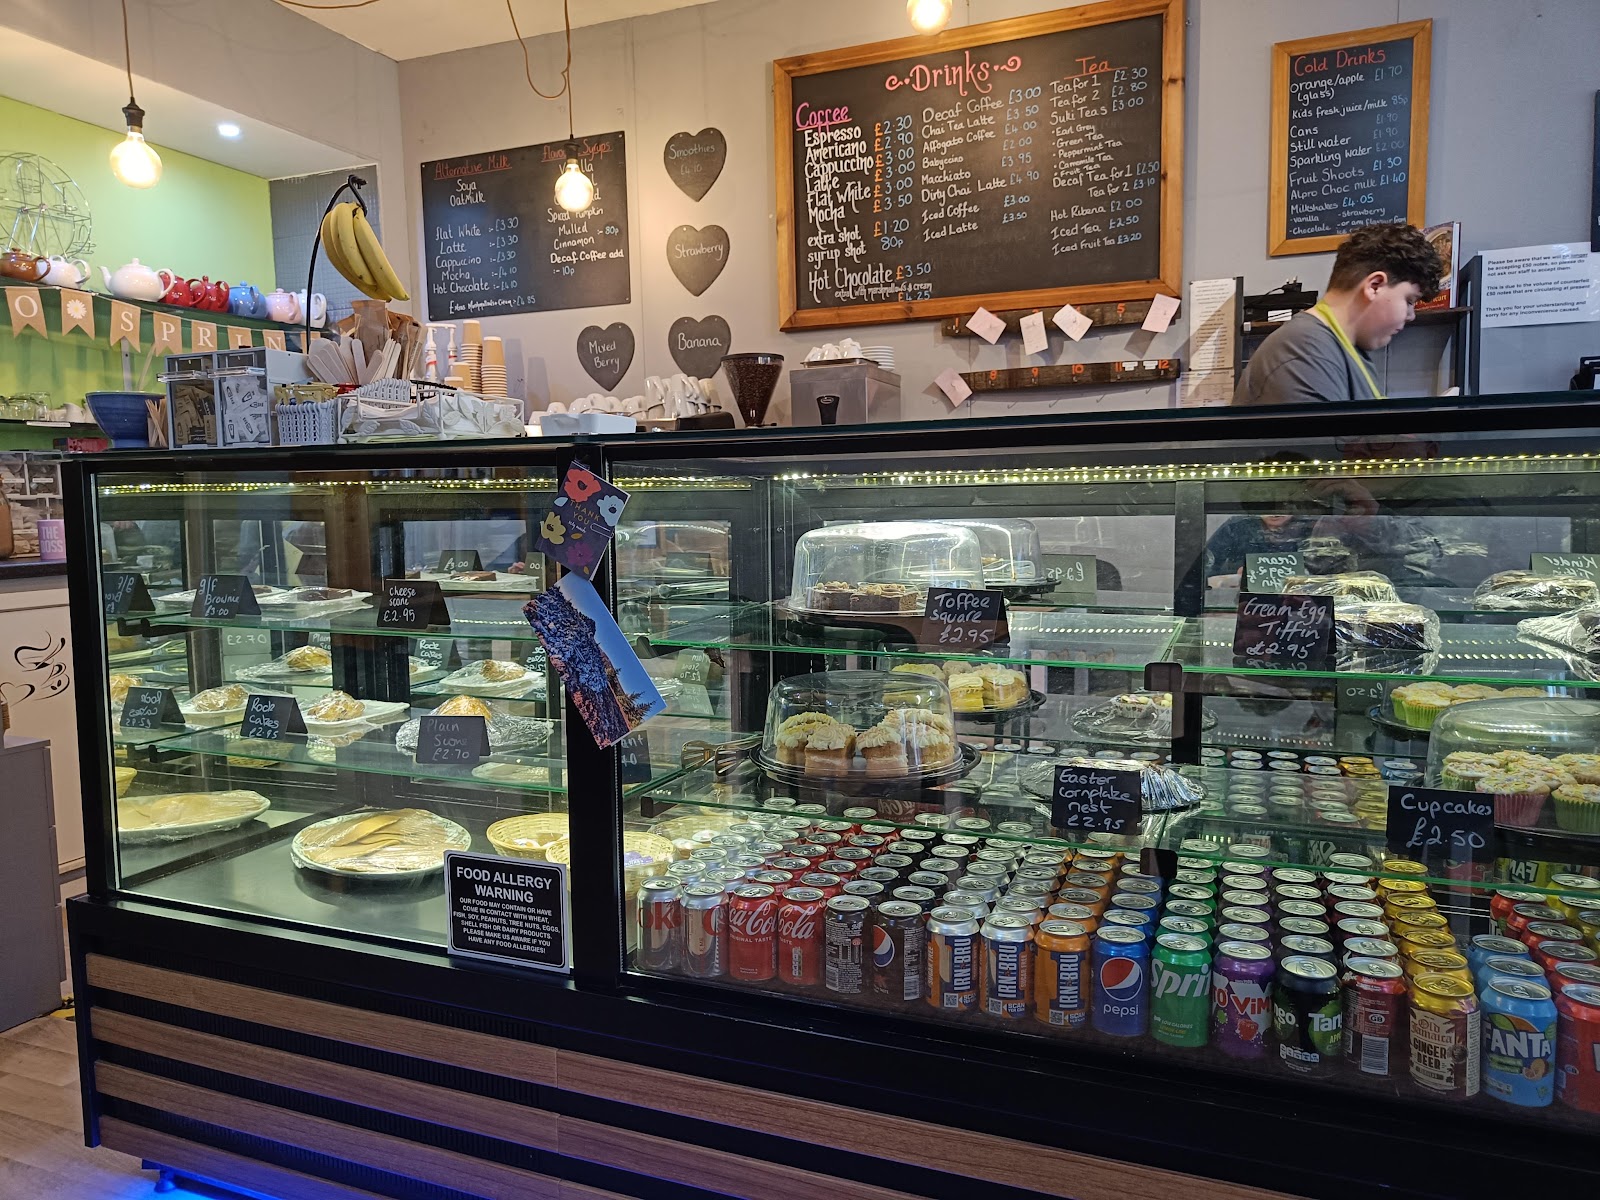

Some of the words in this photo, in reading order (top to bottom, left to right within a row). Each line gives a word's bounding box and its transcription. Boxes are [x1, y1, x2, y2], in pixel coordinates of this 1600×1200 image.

[1075, 56, 1111, 75] Tea
[1294, 56, 1328, 77] Cold
[1336, 48, 1386, 68] Drinks
[910, 50, 993, 96] Drinks
[1049, 81, 1072, 94] Tea
[1072, 77, 1089, 92] for
[1092, 75, 1101, 87] 1
[1049, 96, 1071, 108] Tea
[1071, 94, 1087, 108] for
[1092, 90, 1100, 101] 2
[796, 102, 849, 134] Coffee
[922, 102, 962, 123] Decaf
[967, 96, 1005, 113] Coffee
[1049, 109, 1076, 126] Suki
[1292, 109, 1313, 119] Kids
[1316, 106, 1340, 118] fresh
[922, 125, 945, 139] Chai
[947, 119, 964, 131] Tea
[967, 115, 996, 128] Latte
[1056, 126, 1075, 137] Earl
[1076, 124, 1096, 134] Grey
[1290, 125, 1319, 138] Cans
[804, 126, 862, 147] Espresso
[922, 137, 964, 155] Affogato
[966, 130, 996, 143] Coffee
[1056, 138, 1083, 149] Green
[1084, 132, 1105, 141] Tea
[1290, 139, 1315, 153] Still
[1318, 136, 1352, 149] water
[805, 140, 867, 163] Americano
[1058, 143, 1104, 159] Peppermint
[1104, 140, 1123, 148] Tea
[1095, 152, 1114, 161] Tea
[435, 161, 483, 179] Alternative
[488, 155, 511, 169] Milk
[804, 156, 874, 178] Cappuccino
[922, 154, 964, 170] Babyccino
[1290, 151, 1341, 169] Sparkling
[921, 169, 971, 185] Macchiato
[1052, 172, 1084, 188] Decaf
[1060, 168, 1081, 177] Fruit
[1289, 171, 1319, 187] Fruit
[1321, 167, 1365, 182] Shoots
[456, 179, 477, 194] Soya
[806, 176, 840, 194] Latte
[921, 188, 946, 206] Dirty
[947, 183, 972, 198] Chai
[977, 177, 1007, 192] Latte
[1087, 185, 1105, 197] Tea
[1122, 182, 1130, 191] 2
[1290, 189, 1318, 201] Alpro
[1321, 184, 1350, 196] Choc
[922, 208, 945, 224] Iced
[947, 201, 980, 218] Coffee
[1050, 209, 1069, 222] Hot
[1290, 201, 1339, 215] Milkshakes
[808, 205, 846, 232] Mocha
[558, 221, 588, 236] Mulled
[838, 225, 862, 247] shot
[923, 226, 946, 242] Iced
[949, 221, 978, 235] Latte
[1050, 224, 1079, 240] Iced
[1080, 222, 1102, 234] Tea
[440, 242, 467, 255] Latte
[553, 236, 595, 250] Cinnamon
[674, 242, 724, 261] Strawberry
[1051, 243, 1078, 256] Iced
[1080, 238, 1101, 250] Fruit
[550, 251, 578, 264] Decaf
[579, 250, 606, 262] Coffee
[609, 249, 624, 258] add
[807, 248, 841, 269] syrup
[845, 241, 867, 263] shot
[881, 236, 903, 250] 80p
[436, 256, 482, 271] Cappuccino
[441, 270, 470, 281] Mocha
[808, 270, 832, 303] Hot
[835, 263, 893, 299] Chocolate
[433, 283, 448, 294] Hot
[450, 278, 490, 293] Chocolate
[14, 296, 38, 318] O
[1117, 303, 1125, 313] 5
[588, 341, 617, 355] Mixed
[678, 332, 722, 351] Banana
[594, 356, 620, 374] Berry
[1072, 364, 1084, 374] 10
[570, 500, 600, 522] THANK
[573, 511, 590, 526] YOU
[41, 526, 59, 540] THE
[41, 540, 63, 553] BOSS
[935, 593, 990, 610] Toffee
[383, 609, 416, 622] £2.95
[1244, 597, 1292, 617] Cream
[1300, 600, 1327, 626] Egg
[227, 634, 267, 645] £2.70
[939, 626, 993, 643] £2.95
[1258, 621, 1320, 641] Tiffin
[1247, 642, 1315, 658] £2.95
[251, 697, 276, 713] Rock
[249, 727, 278, 739] £2.95
[427, 718, 460, 732] Plain
[432, 749, 470, 761] £2.70
[1059, 769, 1116, 785] Easter
[1068, 802, 1112, 814] nest
[1401, 793, 1492, 819] Cupcakes
[1406, 816, 1485, 849] £2.50
[457, 866, 491, 882] FOOD
[493, 872, 552, 890] ALLERGY
[475, 884, 534, 903] WARNING
[463, 905, 479, 913] COME
[487, 909, 512, 918] CONTACT
[513, 912, 528, 920] WITH
[472, 899, 488, 907] FOOD
[502, 903, 527, 912] CONTAIN
[527, 906, 536, 914] OR
[537, 909, 552, 917] HAVE
[461, 919, 478, 928] SHELL
[479, 922, 492, 930] FISH
[502, 926, 519, 935] DAIRY
[509, 919, 524, 927] TREE
[463, 928, 485, 937] PLEASE
[485, 931, 501, 939] MAKE
[511, 935, 532, 944] AWARE
[538, 939, 551, 947] YOU
[468, 936, 483, 944] HAVE
[484, 938, 495, 946] ANY
[496, 940, 512, 948] FOOD
[513, 943, 546, 954] ALLERGIES!
[1103, 1003, 1139, 1018] pepsi
[1371, 1014, 1384, 1023] GB
[1484, 1020, 1551, 1058] FANTA
[1413, 1037, 1447, 1060] GINGER
[1416, 1053, 1441, 1070] BEER
